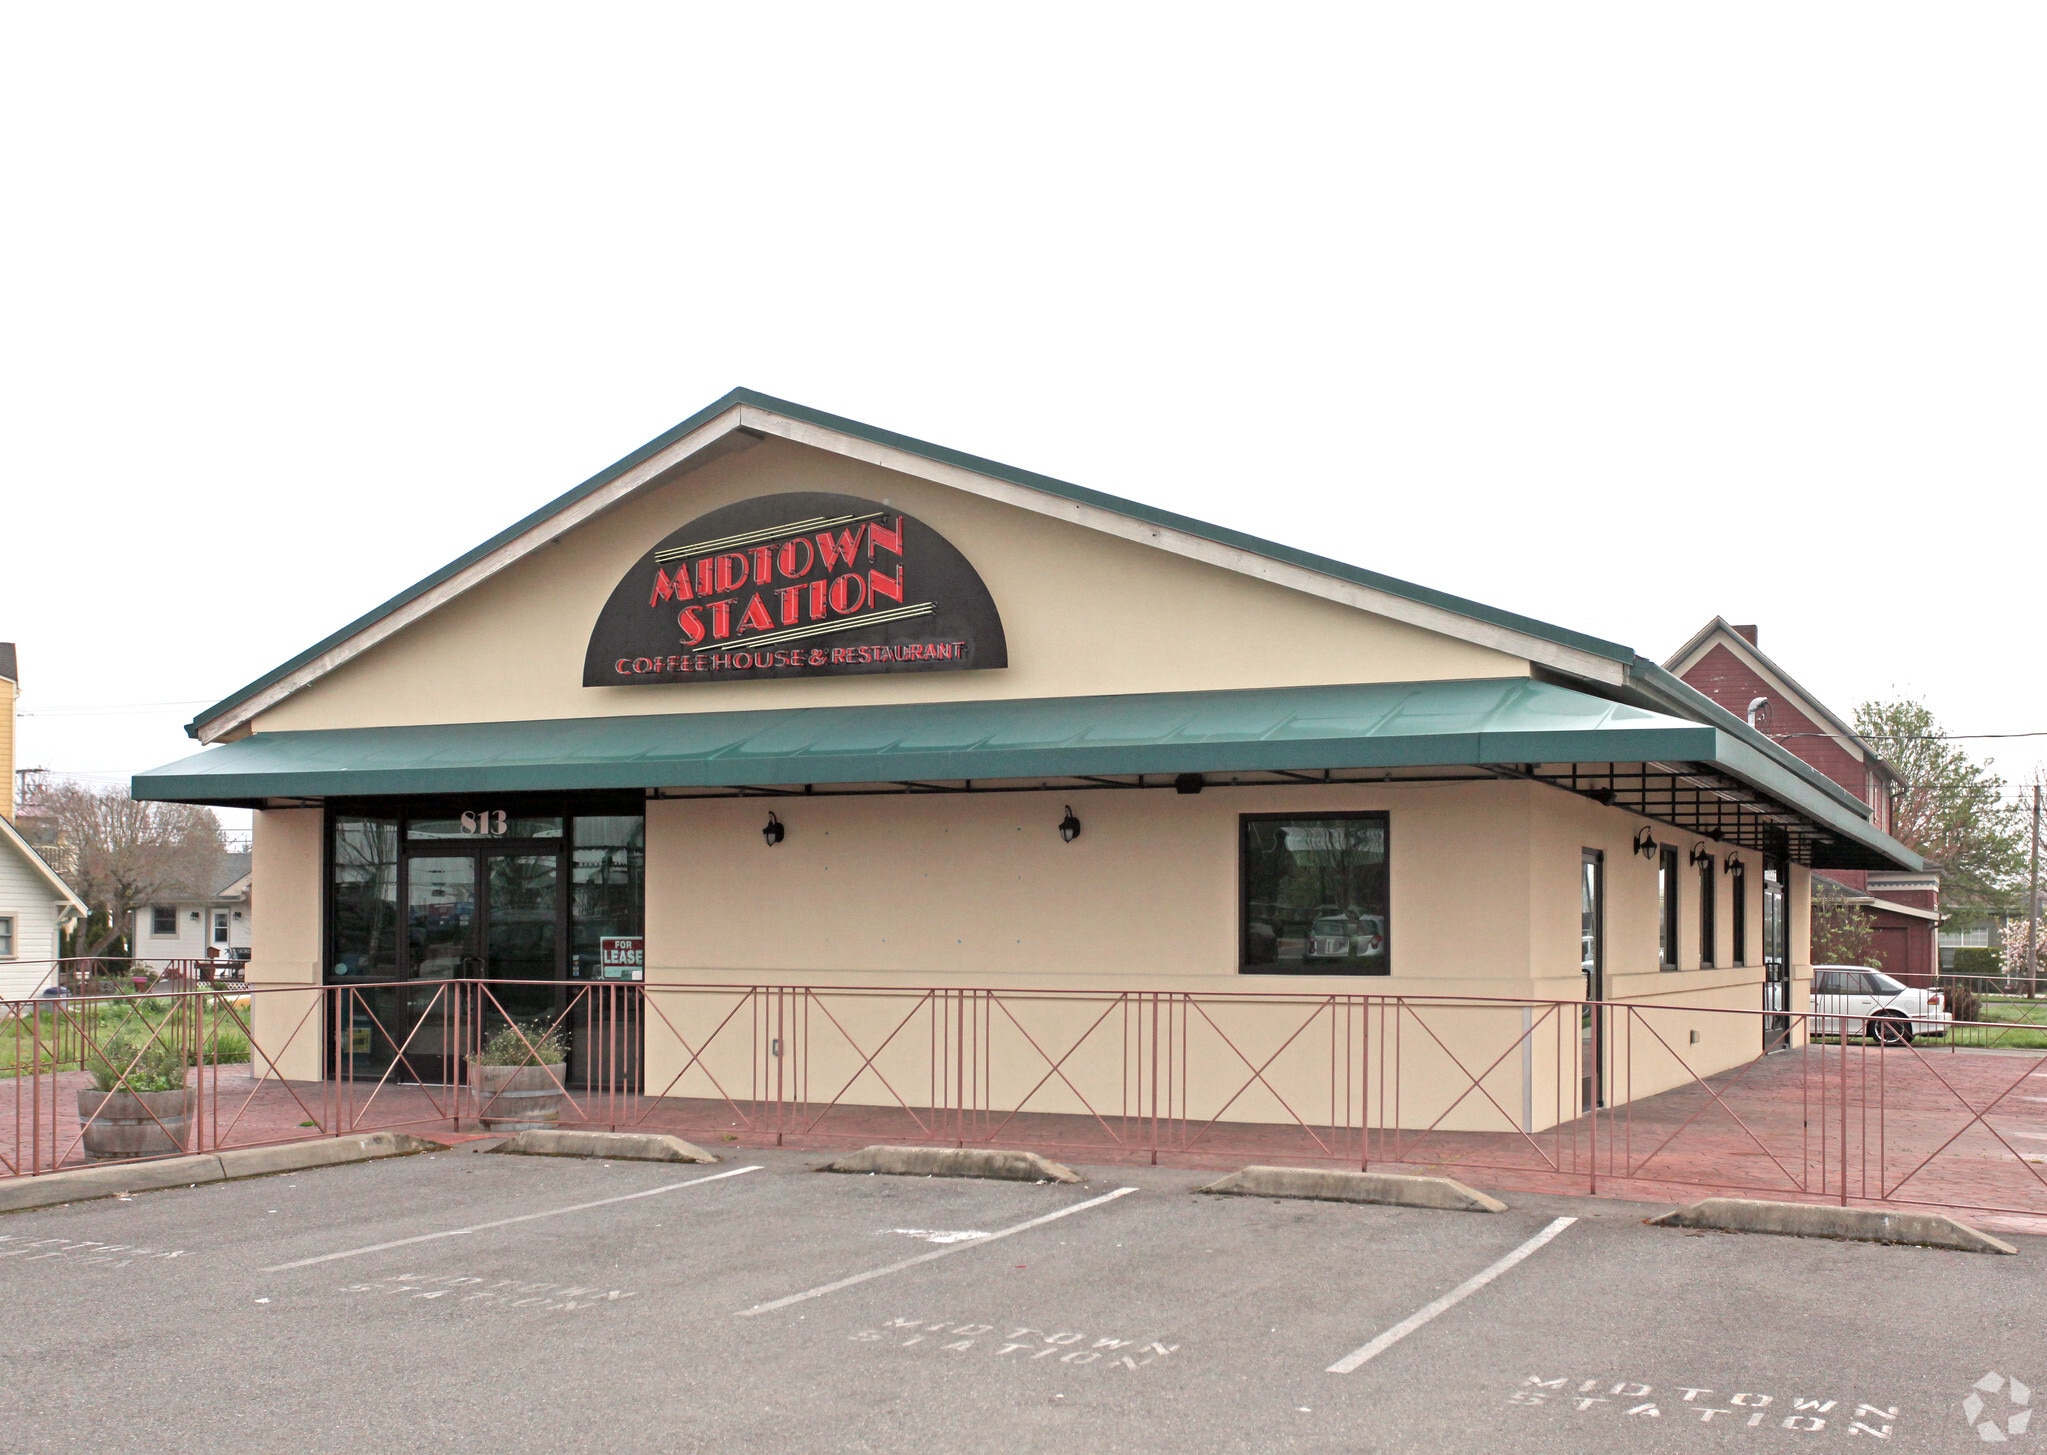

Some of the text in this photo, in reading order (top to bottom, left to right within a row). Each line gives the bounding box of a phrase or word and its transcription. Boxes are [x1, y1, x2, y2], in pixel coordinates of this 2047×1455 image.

[650, 516, 902, 607] MIDTOWN
[677, 562, 902, 646] STATION
[808, 648, 828, 666] &
[831, 641, 965, 664] RESTAURANT
[460, 809, 507, 835] 813
[603, 949, 643, 965] LEASE
[614, 940, 632, 949] FOR
[882, 1317, 1181, 1356] MIDTOWN
[1507, 1390, 1893, 1440] STATION
[1520, 1375, 1900, 1421] MIDTOWN
